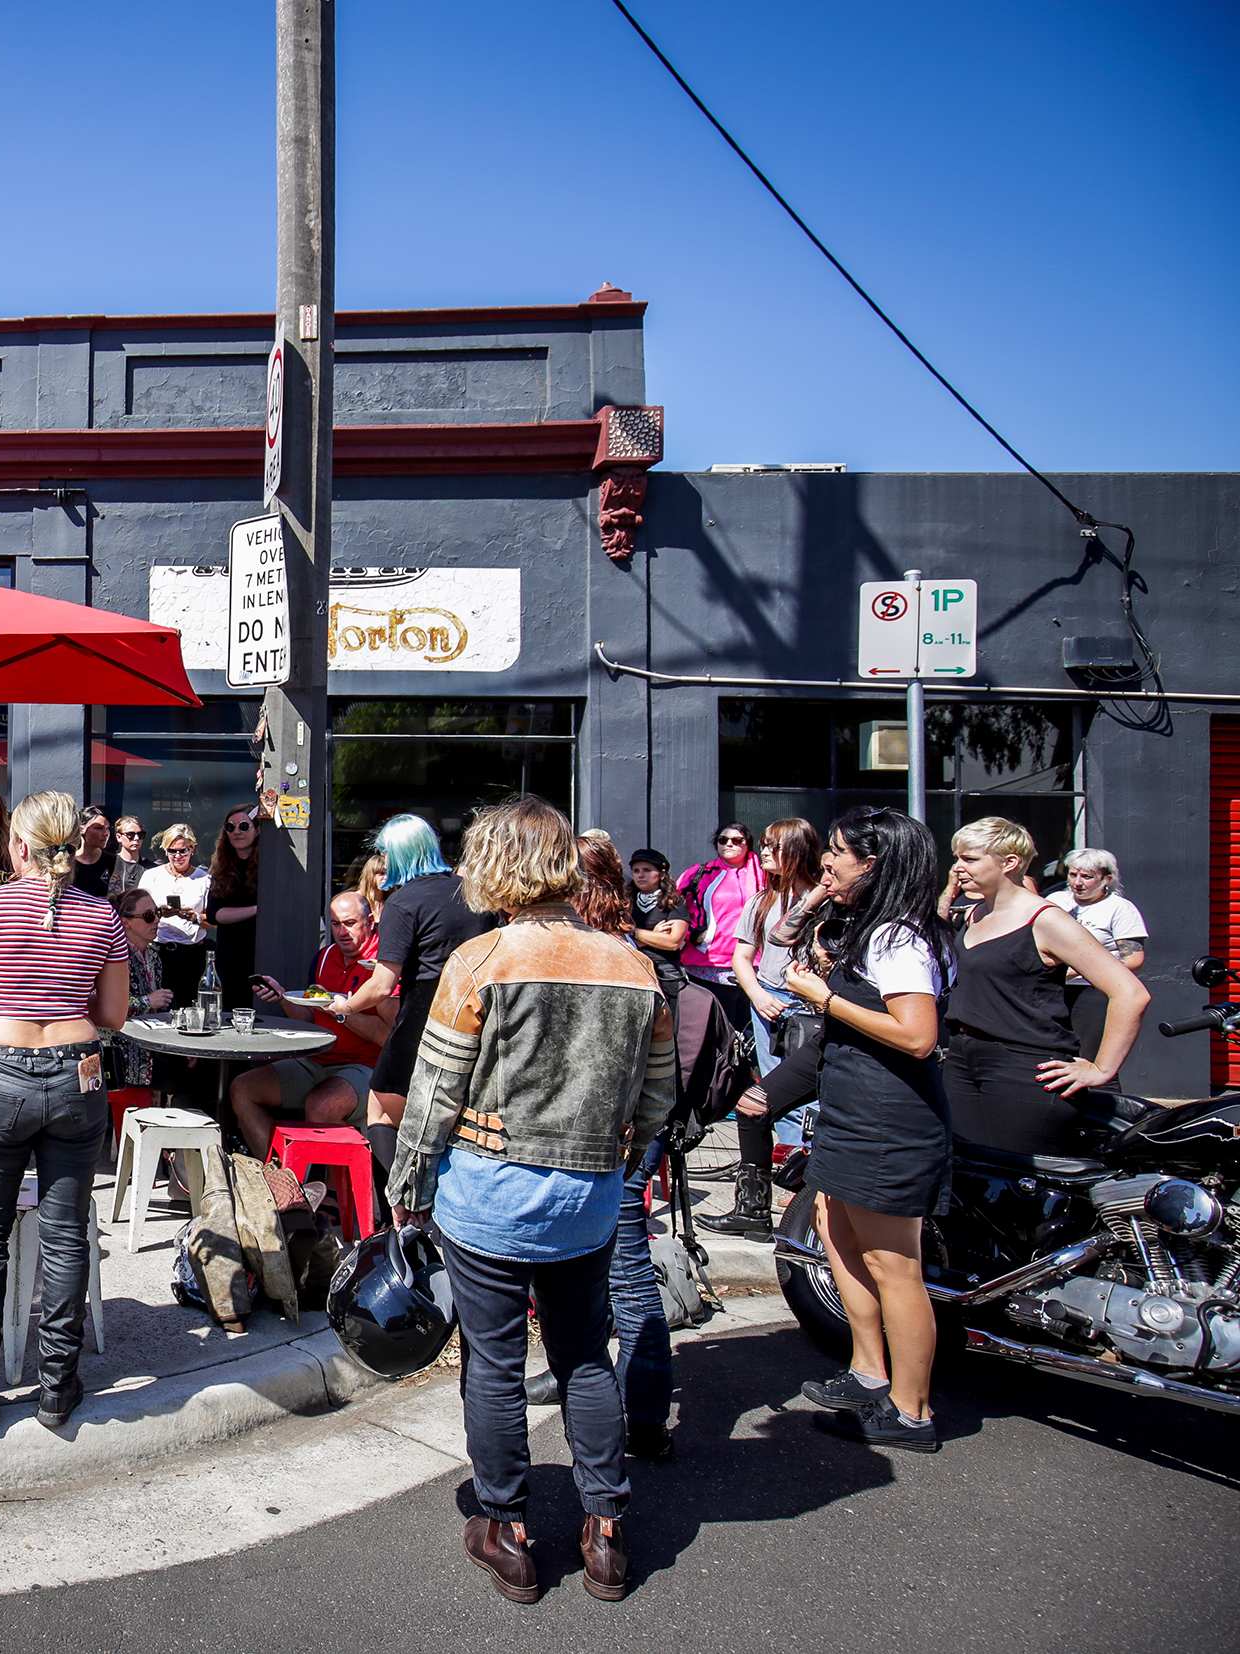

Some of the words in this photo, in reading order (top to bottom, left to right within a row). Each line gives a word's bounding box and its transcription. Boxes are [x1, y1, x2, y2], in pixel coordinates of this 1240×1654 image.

[245, 573, 253, 588] 7
[242, 593, 255, 609] IN
[931, 588, 965, 612] 1P
[238, 618, 264, 643] DO
